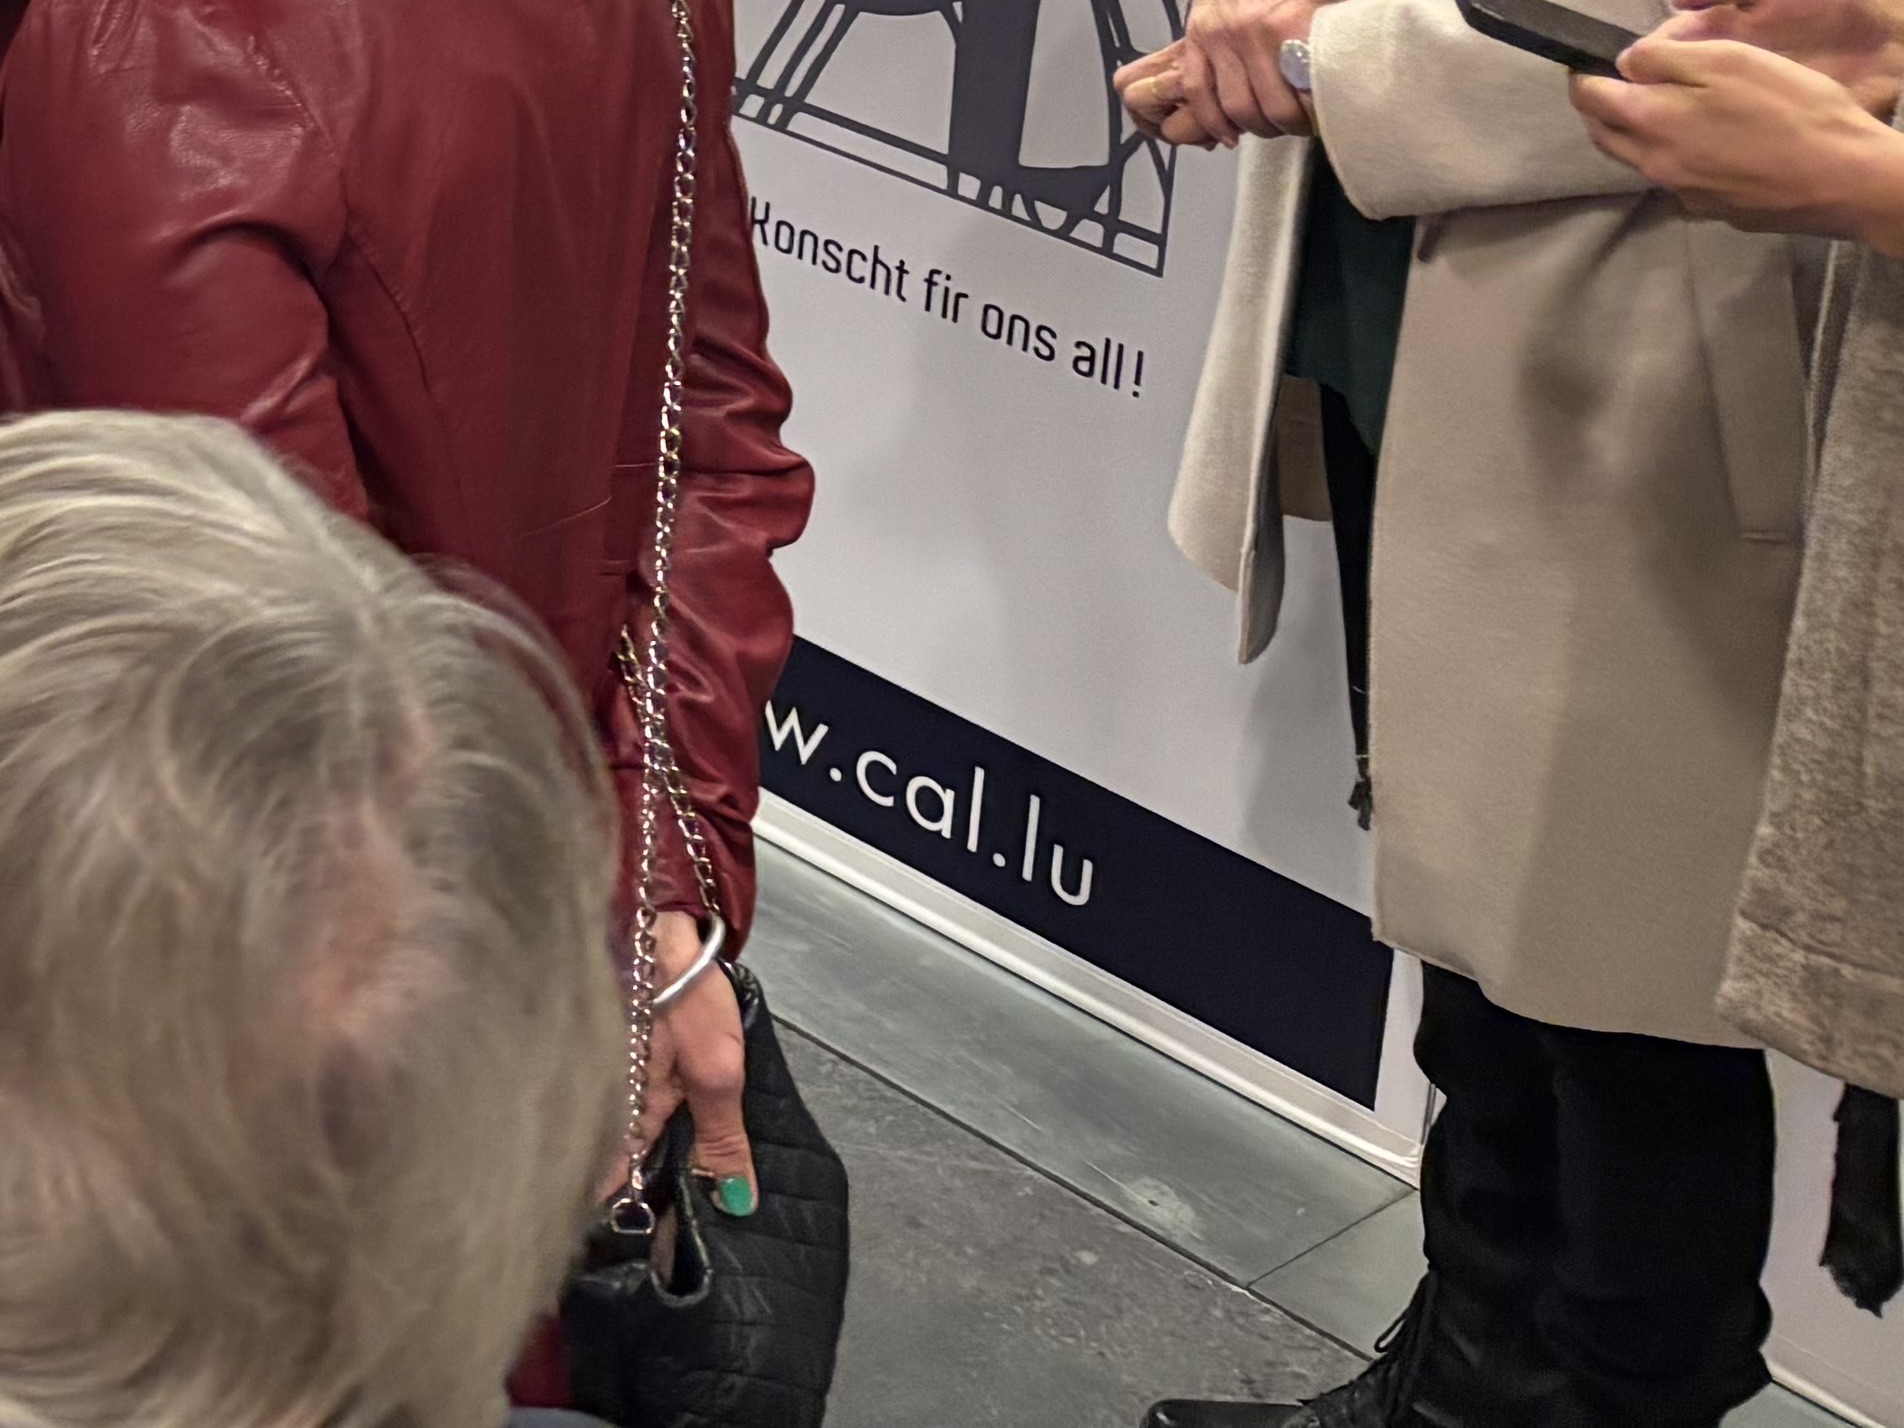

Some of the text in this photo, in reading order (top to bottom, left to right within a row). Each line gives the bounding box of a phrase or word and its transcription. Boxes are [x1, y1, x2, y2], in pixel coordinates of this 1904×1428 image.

[749, 195, 910, 303] Konscht
[923, 267, 970, 324] fir
[980, 302, 1059, 363] ons
[763, 699, 1094, 907] w.cal.lu
